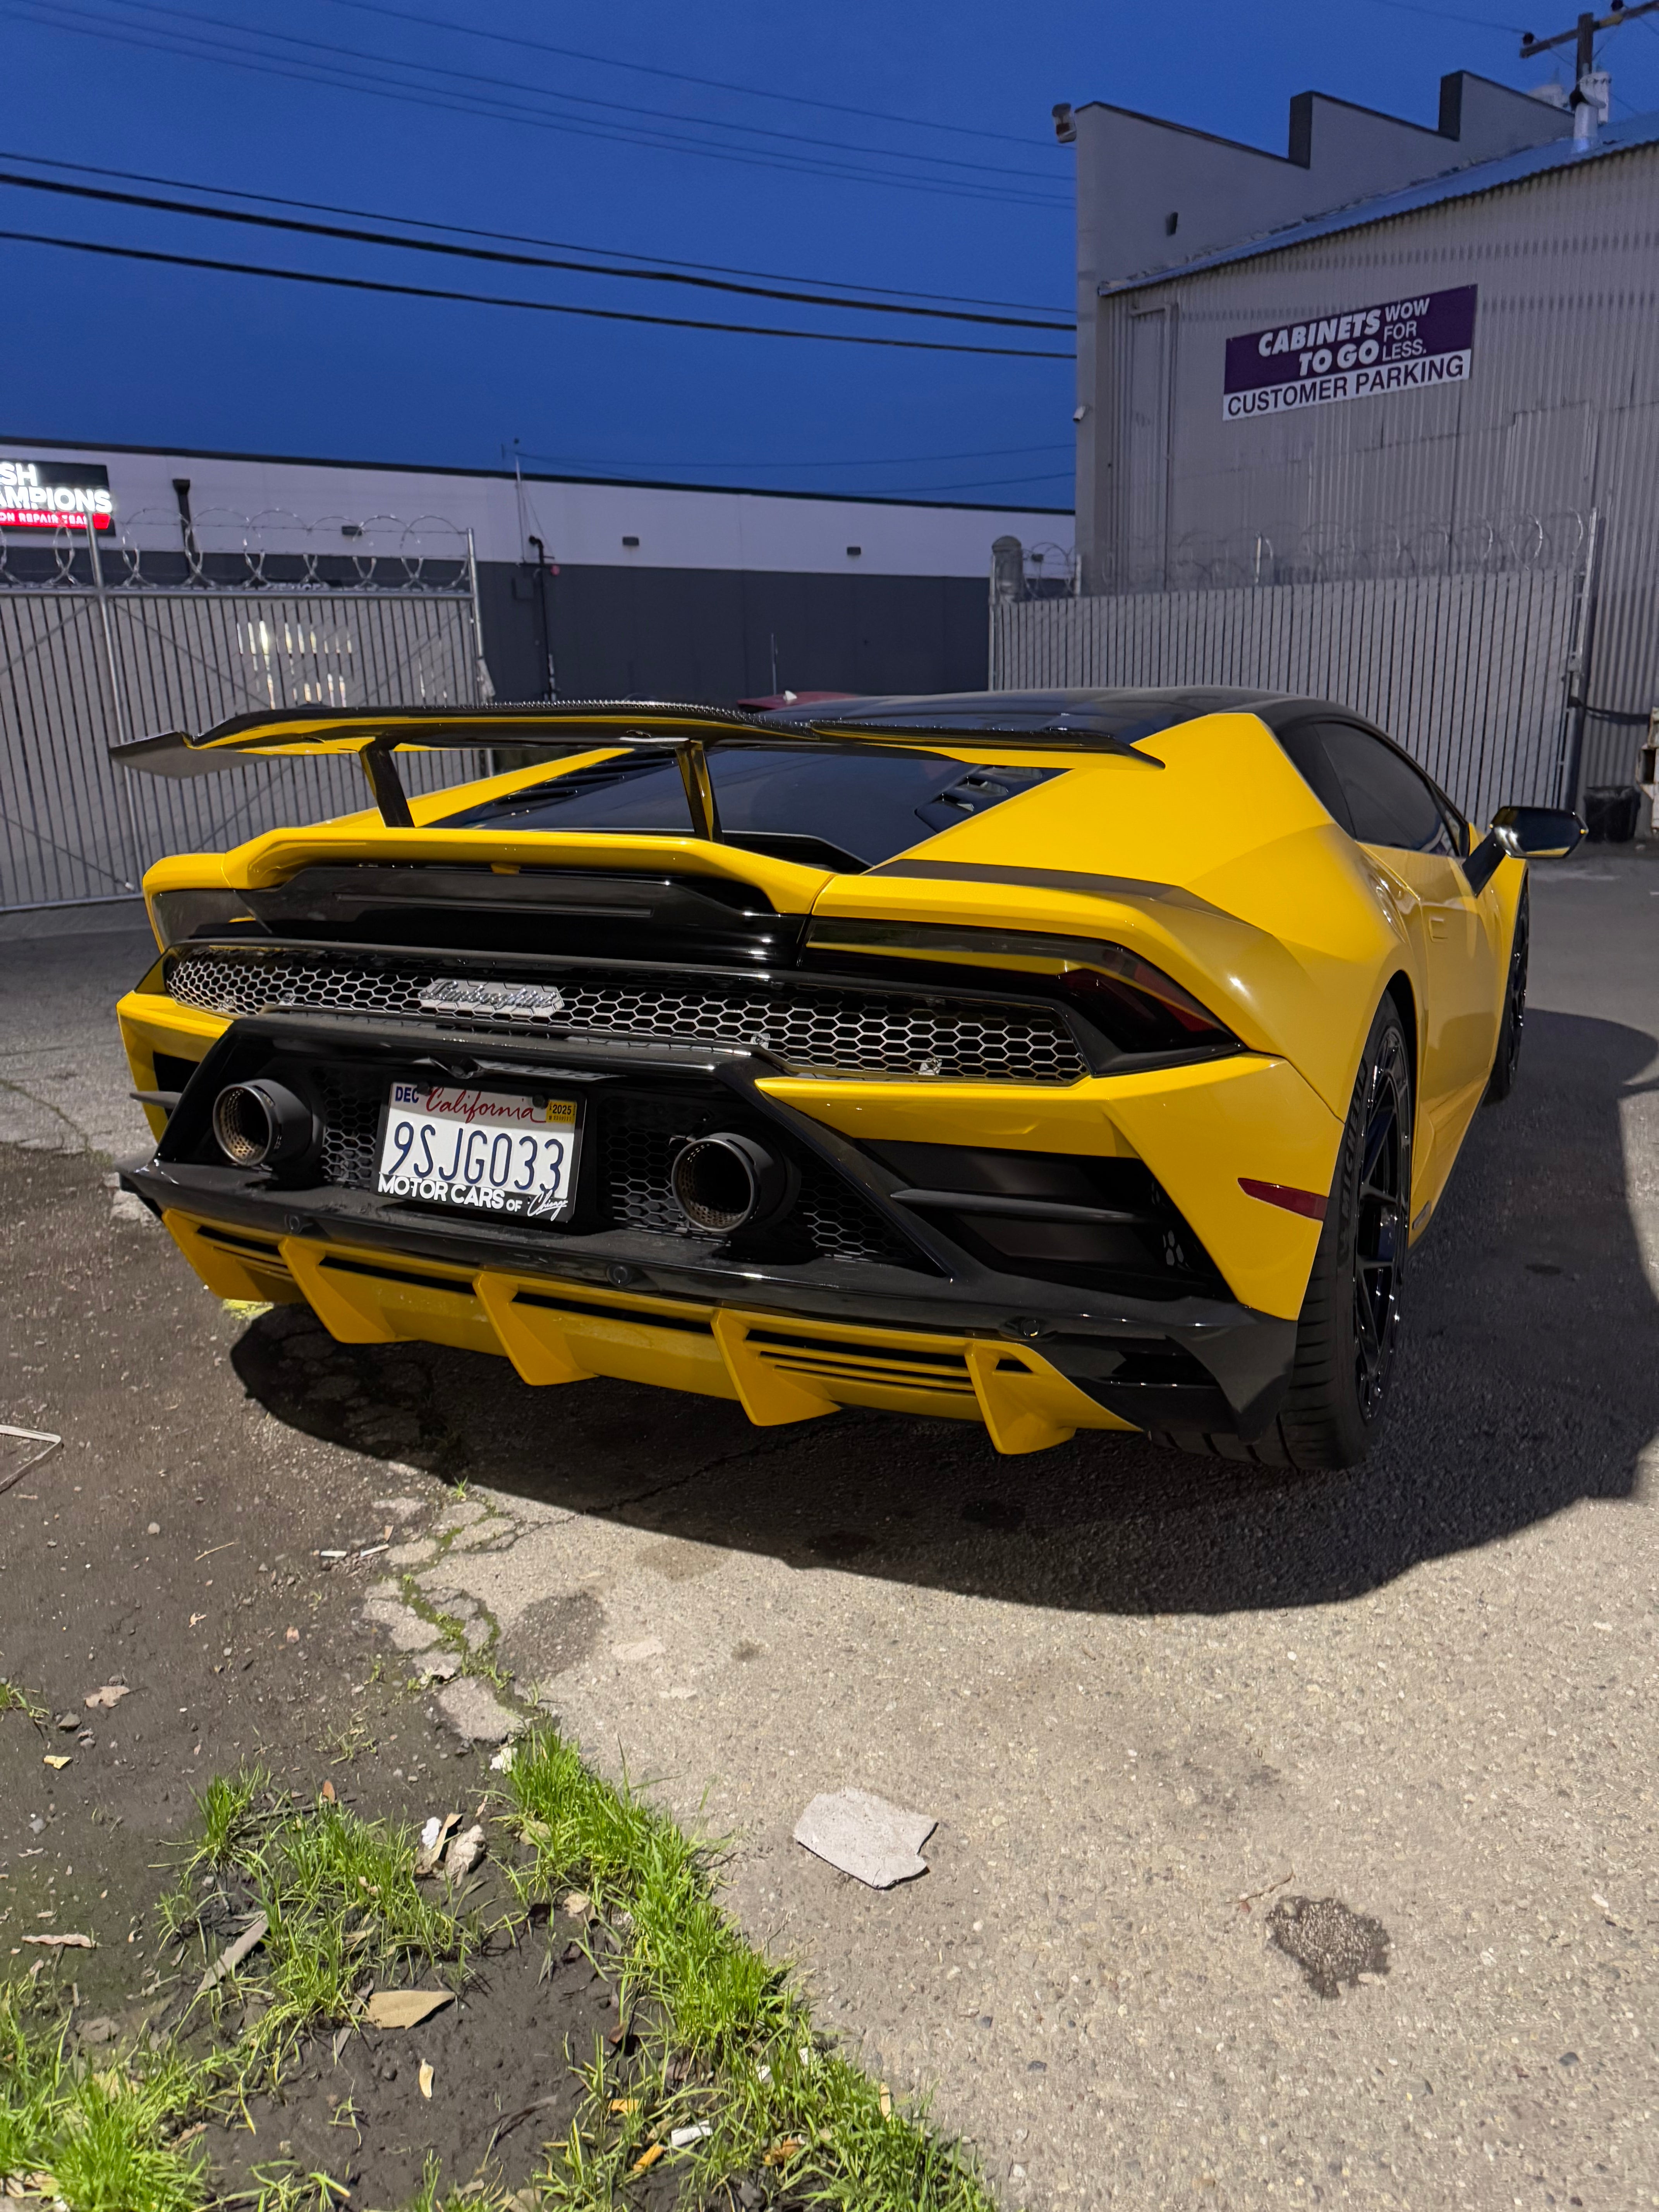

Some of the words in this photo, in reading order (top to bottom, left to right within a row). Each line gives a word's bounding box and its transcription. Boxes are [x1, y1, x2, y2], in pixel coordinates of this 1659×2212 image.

[1385, 297, 1429, 322] WOW
[1259, 309, 1381, 357] CABINETS
[1384, 320, 1417, 342] FOR
[1299, 349, 1332, 376] TO
[1337, 339, 1379, 369] GO
[1382, 338, 1426, 361] LESS.
[1228, 377, 1347, 416] CUSTOMER
[1355, 355, 1463, 394] PARKING
[19, 513, 58, 524] REPAIR
[395, 1086, 419, 1103] DEC
[426, 1087, 547, 1124] California
[553, 1104, 572, 1115] 2025
[388, 1121, 564, 1195] 9SJG033
[378, 1175, 448, 1201] MOTOR
[451, 1184, 505, 1209] CARS
[506, 1199, 522, 1212] OF
